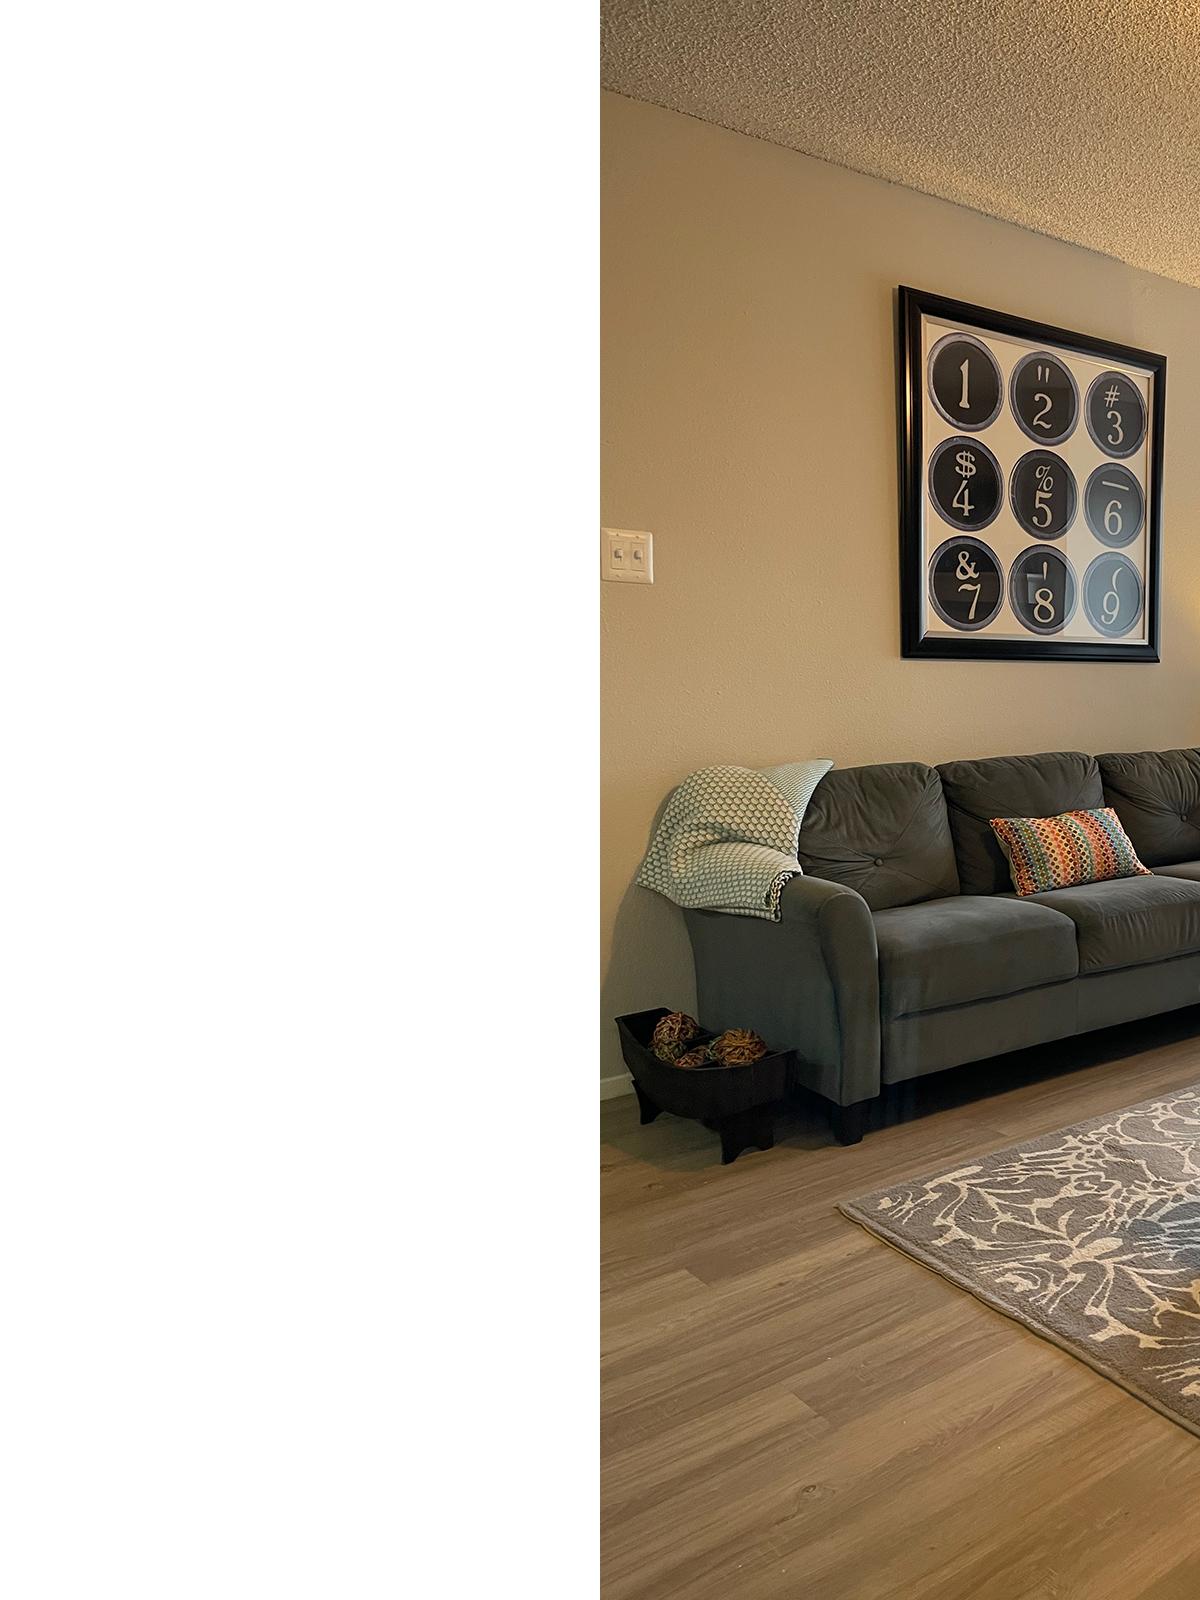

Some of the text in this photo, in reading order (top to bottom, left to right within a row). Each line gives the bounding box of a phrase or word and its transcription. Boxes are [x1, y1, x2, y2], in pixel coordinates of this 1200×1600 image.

[959, 360, 970, 408] 1
[1105, 385, 1120, 407] #
[1033, 393, 1052, 429] 2
[1107, 411, 1123, 445] 3
[956, 451, 976, 478] $
[1036, 465, 1054, 491] %
[952, 480, 974, 516] 4
[1032, 491, 1052, 527] 5
[1104, 500, 1122, 535] 6
[956, 551, 979, 580] &
[958, 584, 981, 620] 7
[1033, 588, 1055, 622] 8
[1101, 591, 1120, 625] 9
